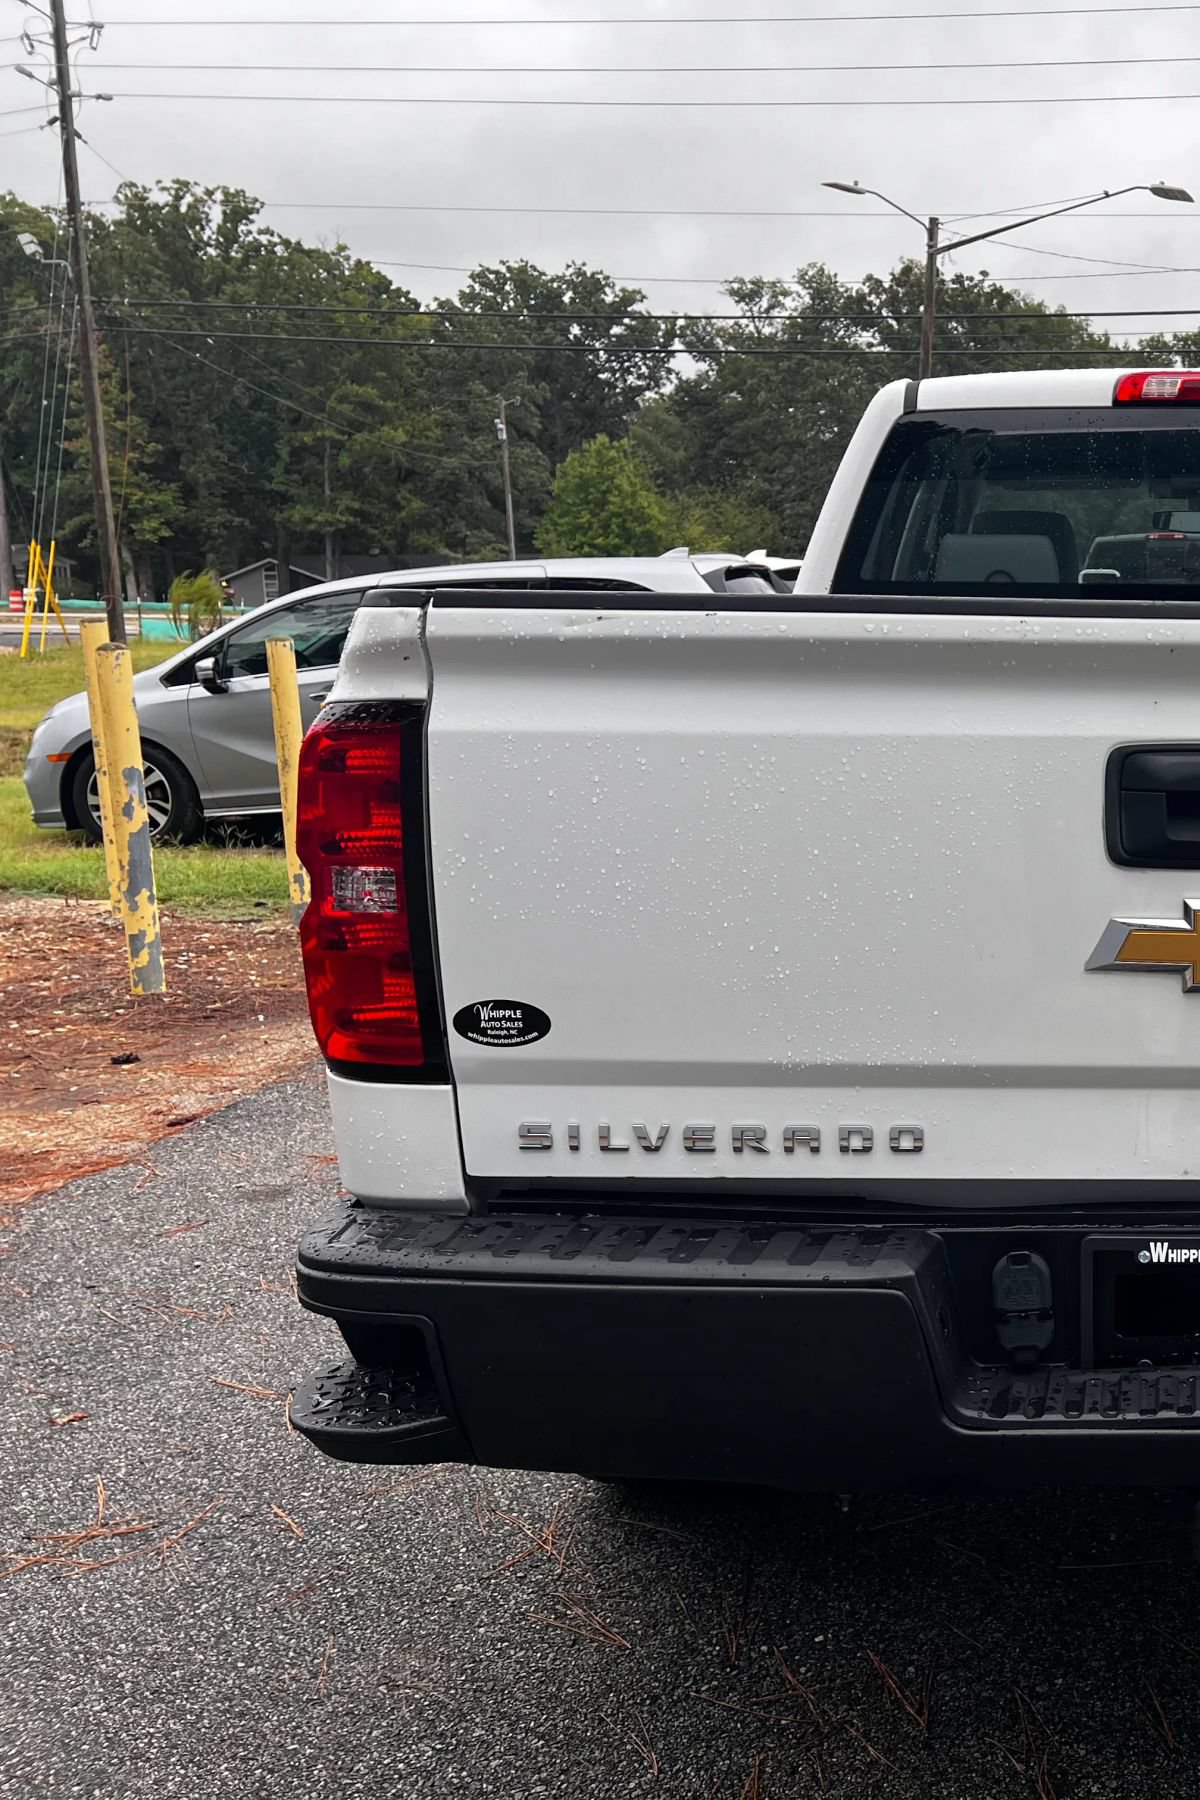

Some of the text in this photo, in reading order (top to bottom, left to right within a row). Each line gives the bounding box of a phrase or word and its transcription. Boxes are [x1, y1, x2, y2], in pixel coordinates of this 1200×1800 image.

[473, 1002, 523, 1021] WHIPPLE
[480, 1020, 523, 1028] AUTO SALES
[467, 1031, 539, 1044] whippleautosales.com
[518, 1122, 925, 1154] SILVERADO
